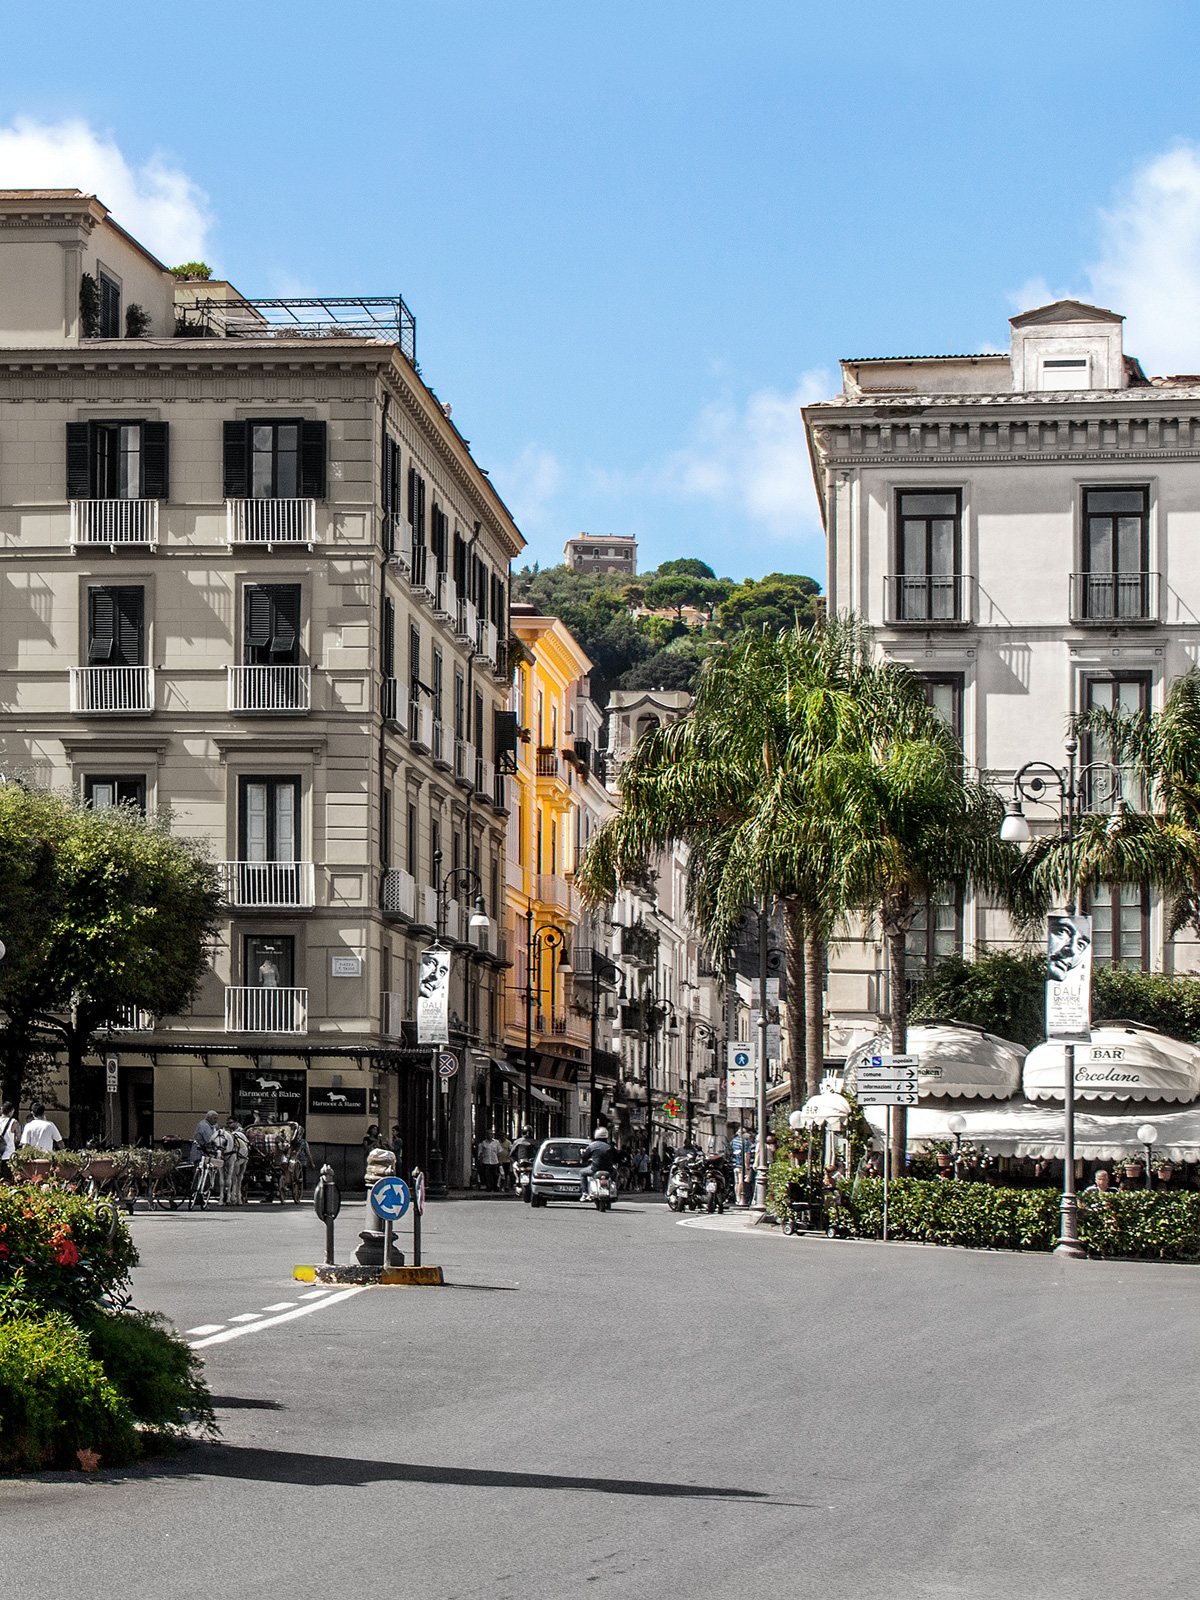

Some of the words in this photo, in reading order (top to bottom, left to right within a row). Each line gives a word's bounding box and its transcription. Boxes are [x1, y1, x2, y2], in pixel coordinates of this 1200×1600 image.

[1093, 1050, 1122, 1059] BAR
[1075, 1067, 1140, 1083] Ercolano
[239, 1090, 269, 1098] Harmont
